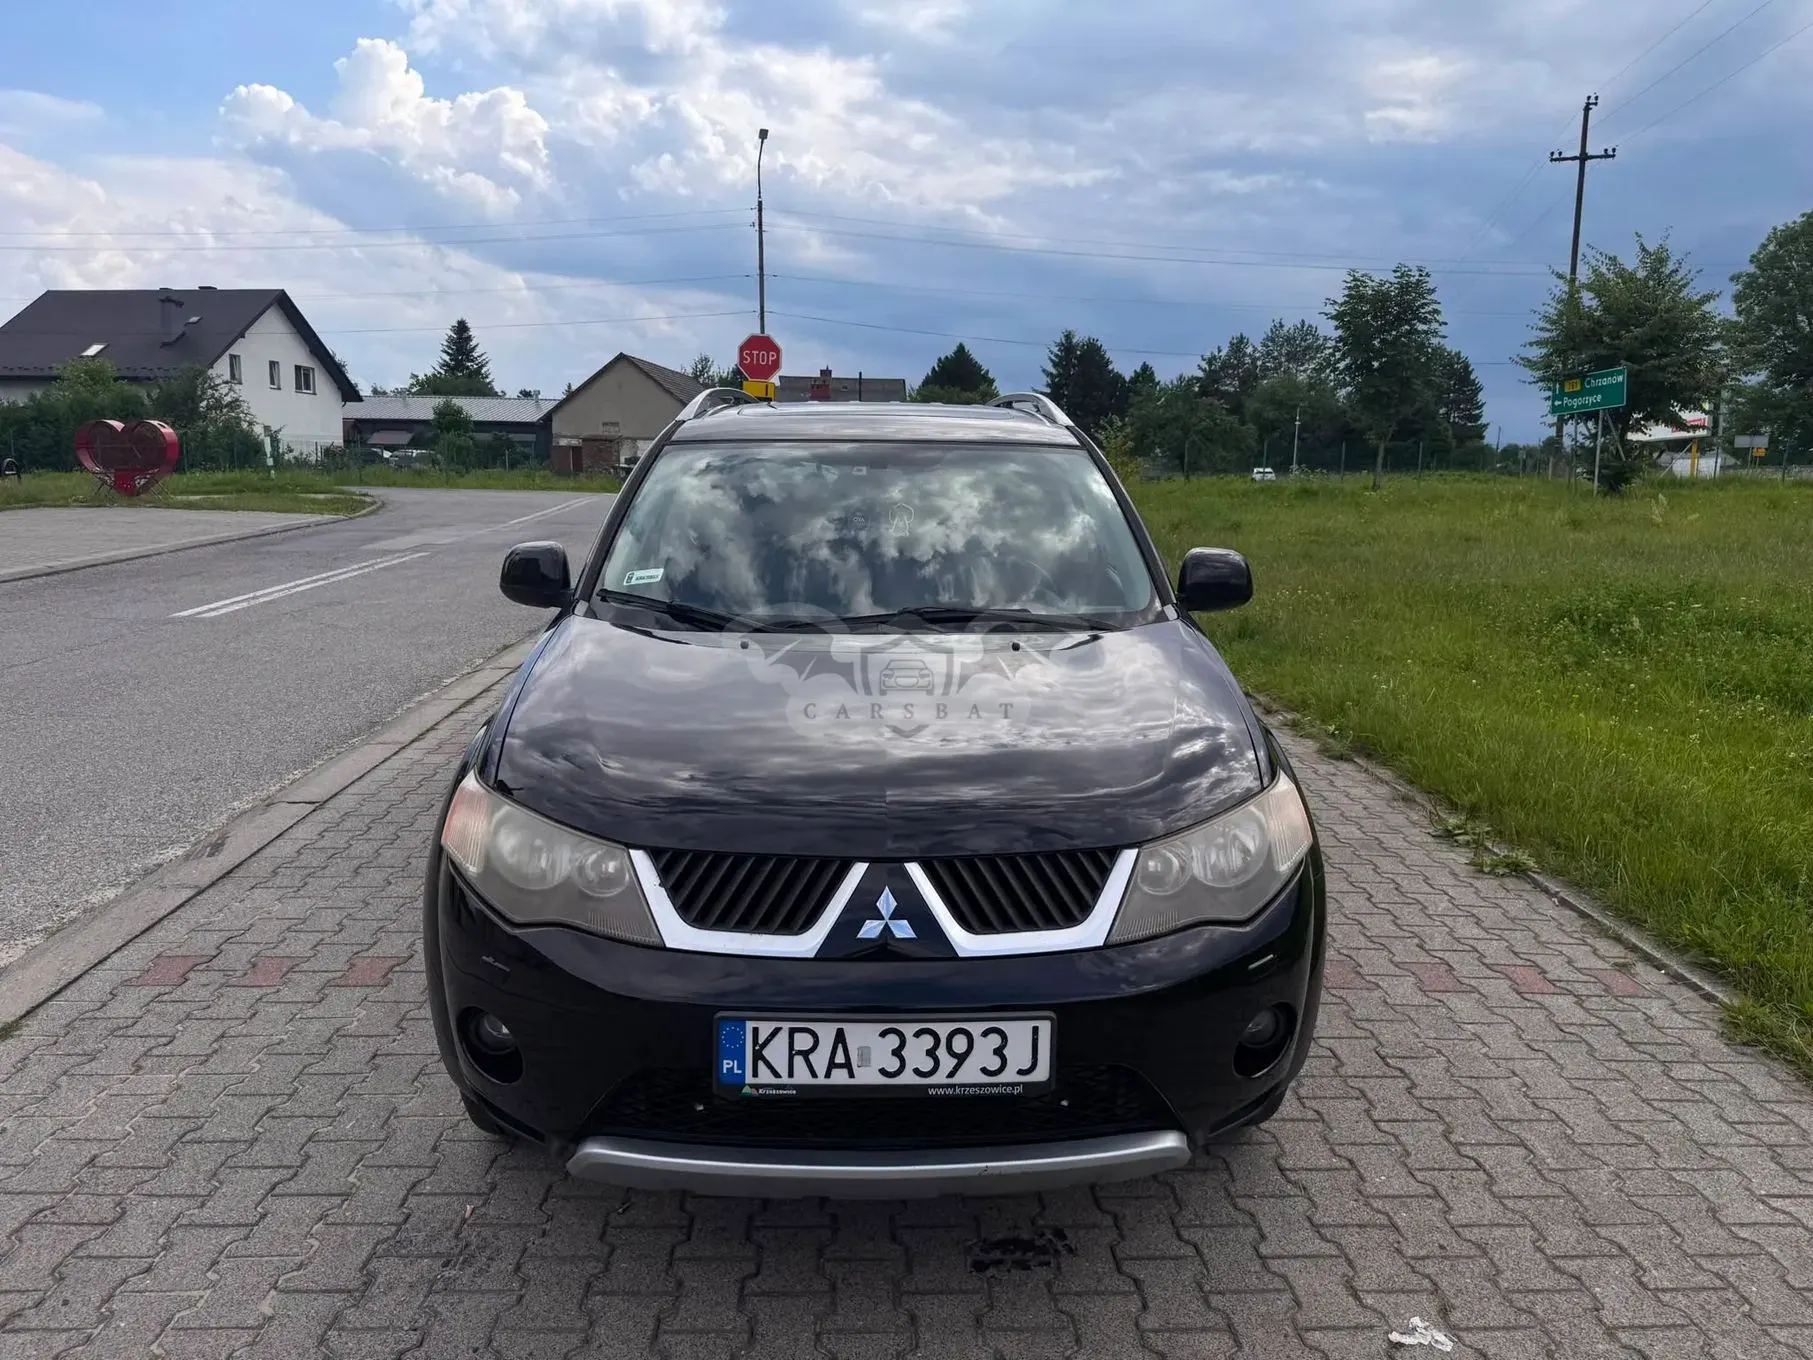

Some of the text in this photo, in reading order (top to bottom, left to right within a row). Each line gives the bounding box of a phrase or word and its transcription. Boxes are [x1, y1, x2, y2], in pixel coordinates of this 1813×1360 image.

[743, 350, 777, 365] STOP
[1584, 373, 1623, 388] Chrzanów
[1563, 394, 1602, 408] Pogorzyce
[752, 1025, 1040, 1079] KRA 3393J
[722, 1059, 743, 1074] PL
[927, 1084, 1023, 1096] www.krzeszowice.pl
